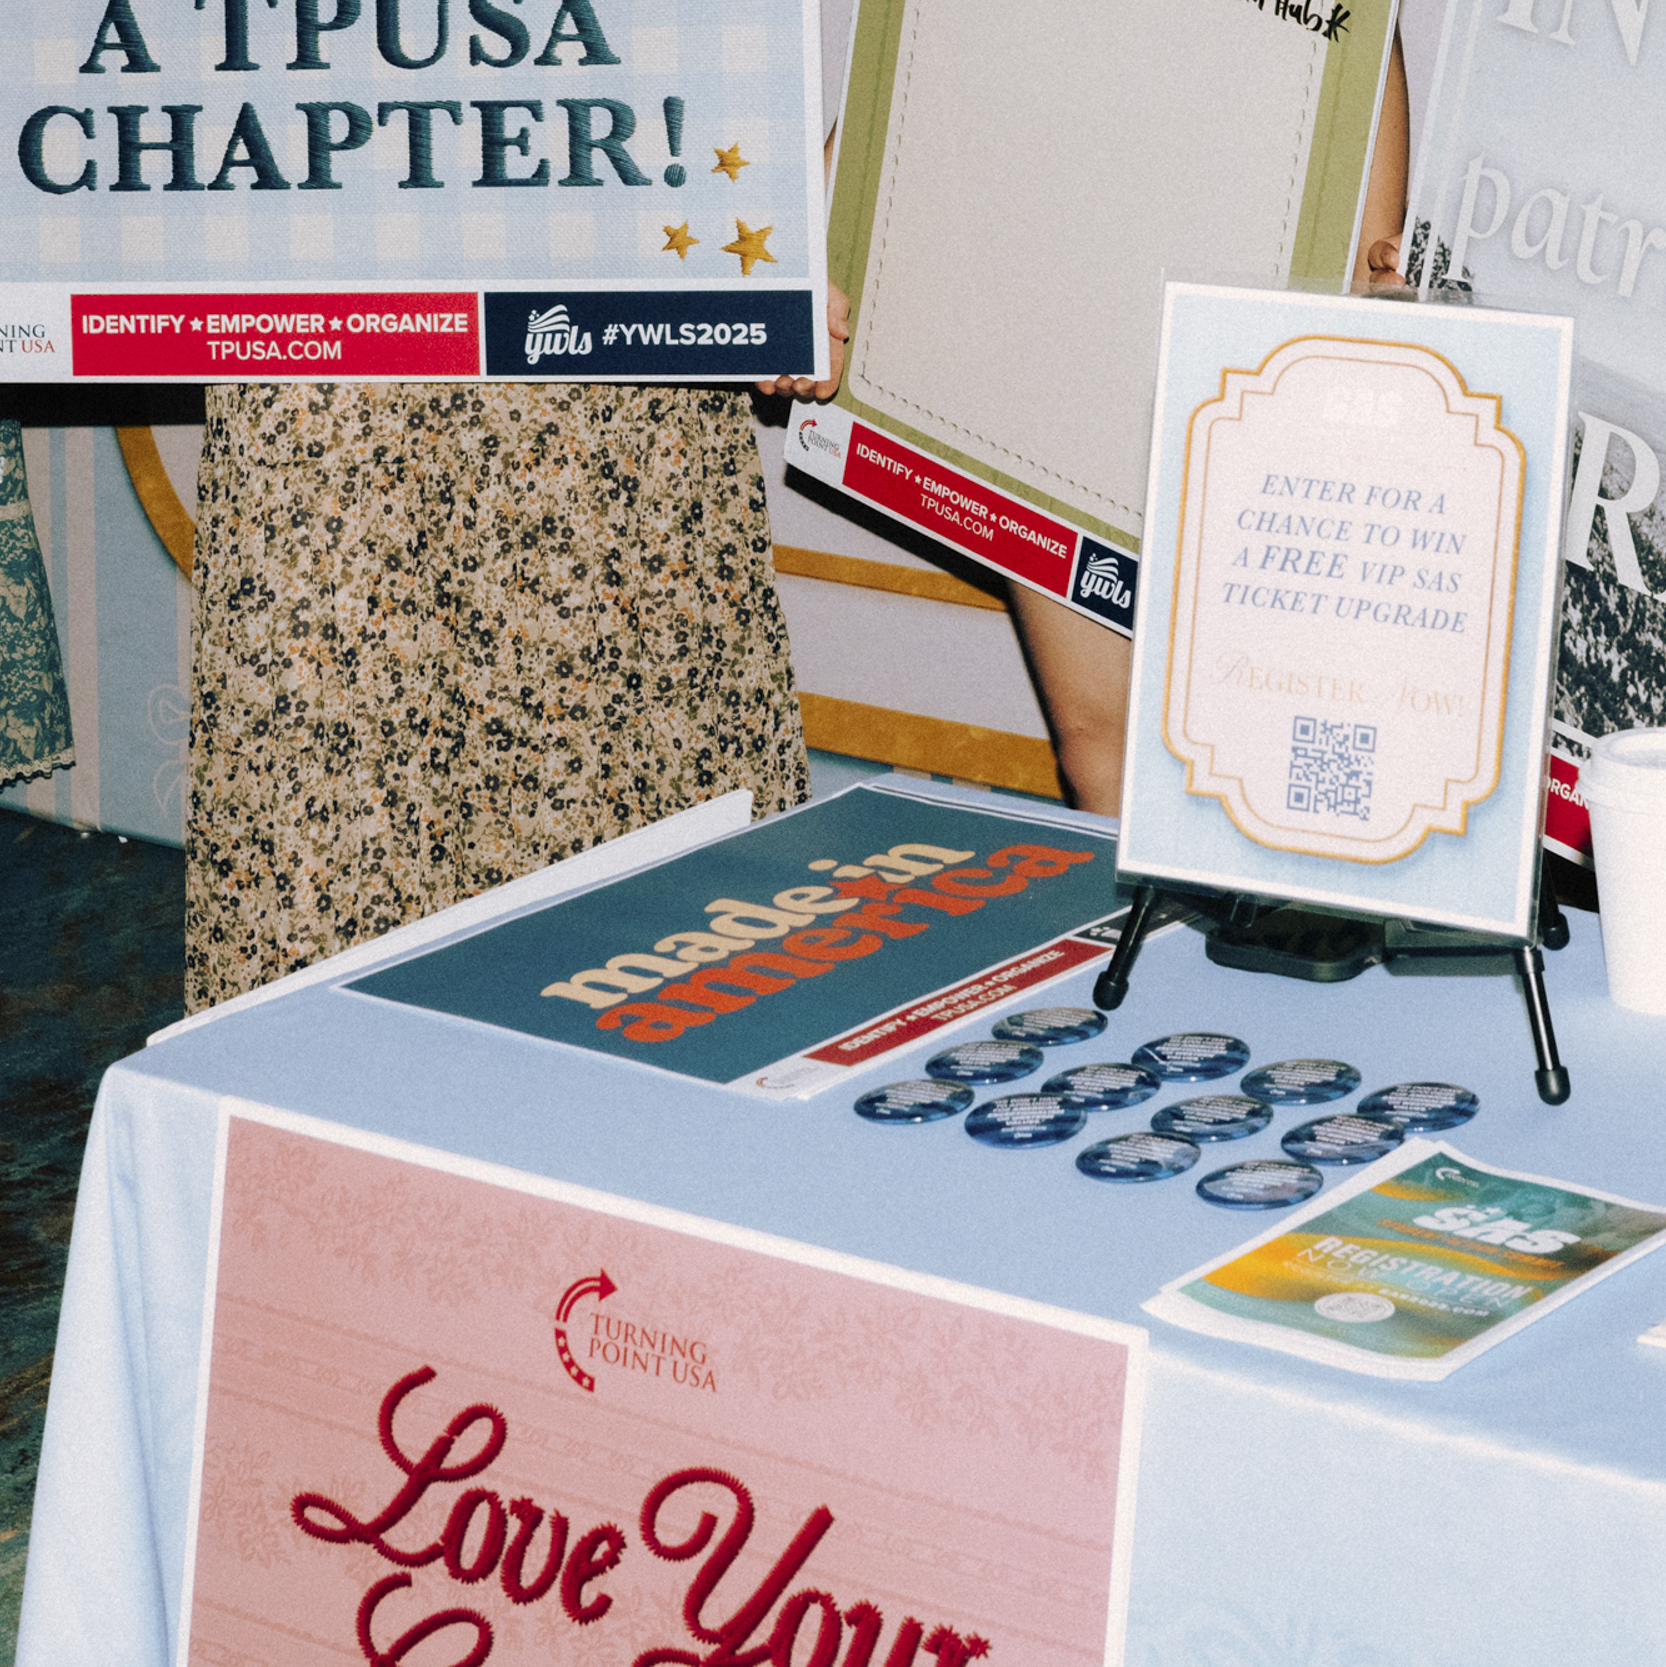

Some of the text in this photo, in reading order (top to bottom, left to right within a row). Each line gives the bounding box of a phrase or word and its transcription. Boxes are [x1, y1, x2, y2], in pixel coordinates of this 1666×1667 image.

[17, 95, 687, 195] CHAPTER!
[21, 338, 57, 353] USA
[81, 312, 470, 334] IDENTIFY EMPOWER ORGANIZE
[602, 323, 768, 347] #YWLS2025
[207, 340, 344, 362] TPUSA.COM
[855, 442, 1069, 560] IDENTIFY EMPOWER ORGANIZE
[920, 493, 995, 543] TPUSA.COM
[1260, 473, 1447, 516] ENTER FOR A
[1237, 508, 1468, 556] CHANCE TO WIN
[1231, 543, 1463, 594] A FREE VIP SAS
[1222, 581, 1470, 634] TICKET UPGRADE
[539, 842, 976, 1010] made in
[594, 844, 1096, 1043] america
[837, 948, 1066, 1052] IDENTIFY EMPOWER ORGANIZE
[930, 983, 1018, 1022] TPUSA.COM
[1412, 1202, 1582, 1254] SAS
[1313, 1235, 1534, 1299] REGISTRATION
[587, 1336, 718, 1394] POINT USA
[588, 1311, 708, 1367] TURNING
[290, 1363, 629, 1626] Love
